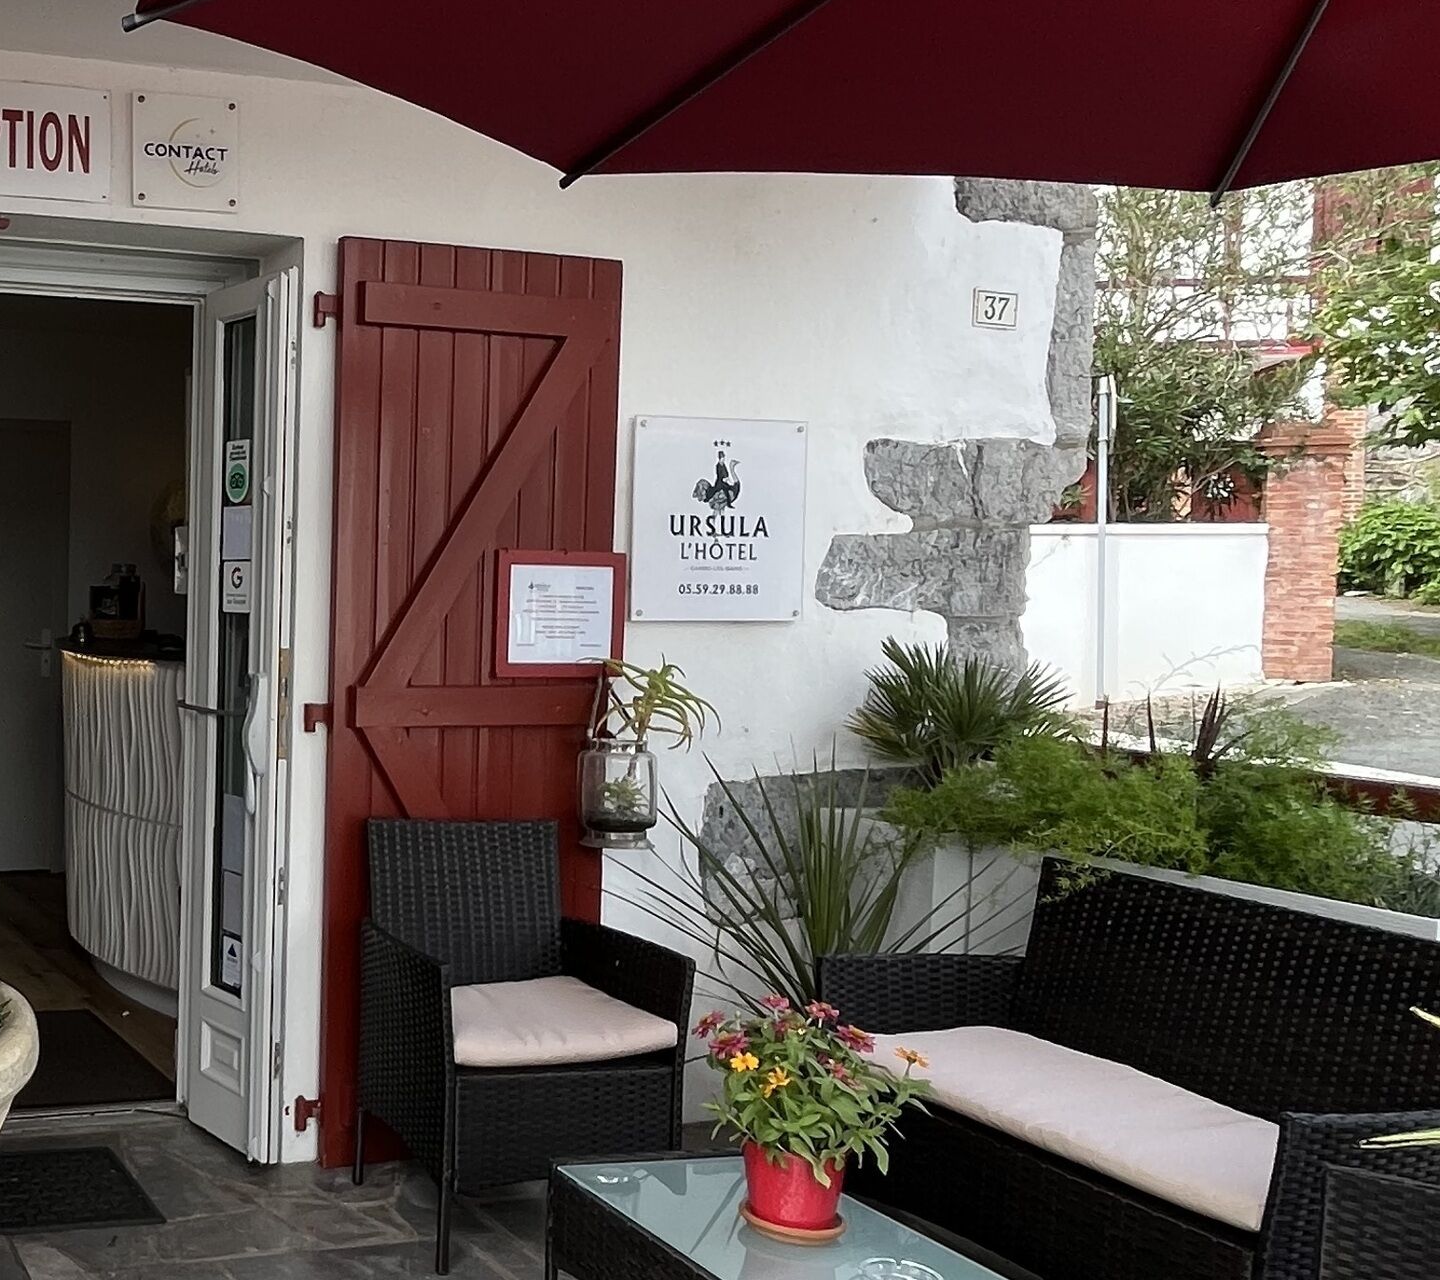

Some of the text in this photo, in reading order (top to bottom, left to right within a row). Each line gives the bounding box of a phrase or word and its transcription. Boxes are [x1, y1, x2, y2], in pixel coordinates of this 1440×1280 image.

[143, 142, 229, 162] CONTACT
[984, 295, 1010, 321] 37
[669, 514, 769, 538] URSULA
[680, 538, 758, 560] L'HÔTEL
